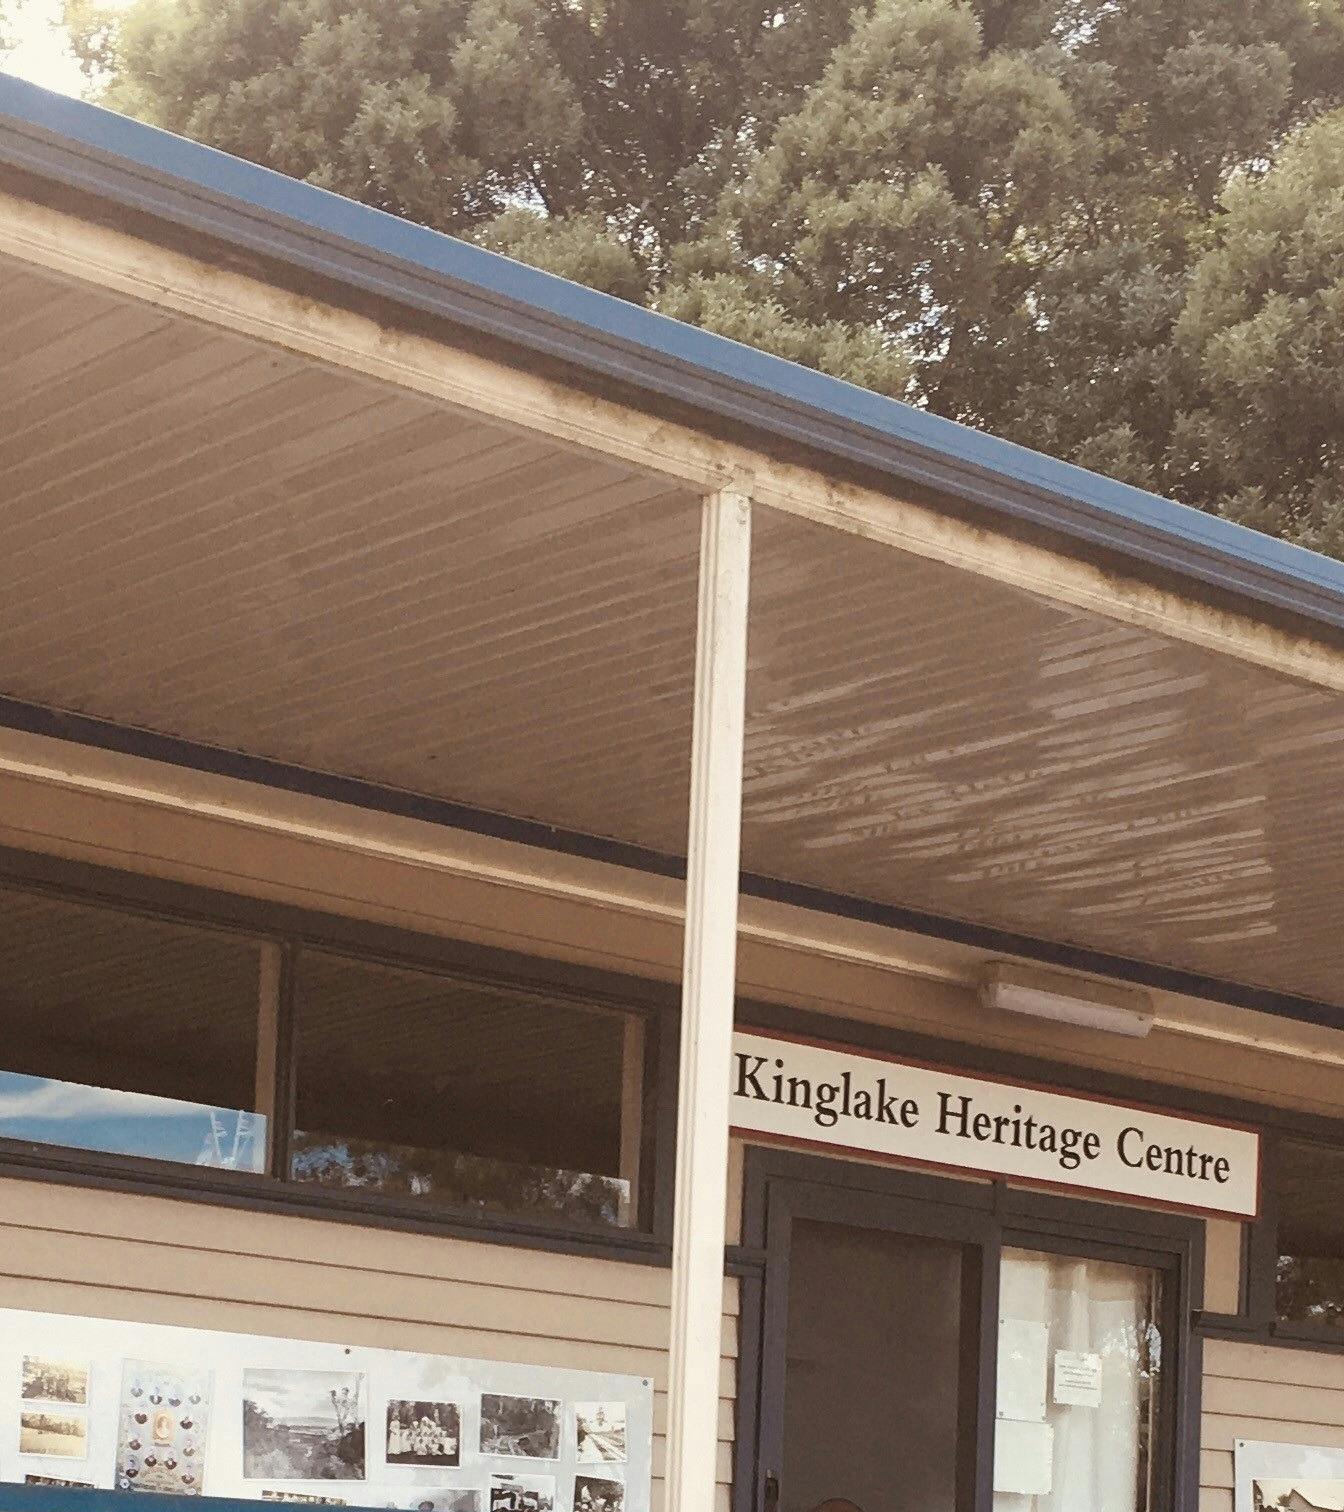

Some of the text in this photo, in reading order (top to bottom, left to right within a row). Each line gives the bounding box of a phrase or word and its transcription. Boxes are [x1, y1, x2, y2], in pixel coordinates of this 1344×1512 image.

[733, 1052, 1231, 1184] Kinglake Heritage Centre
